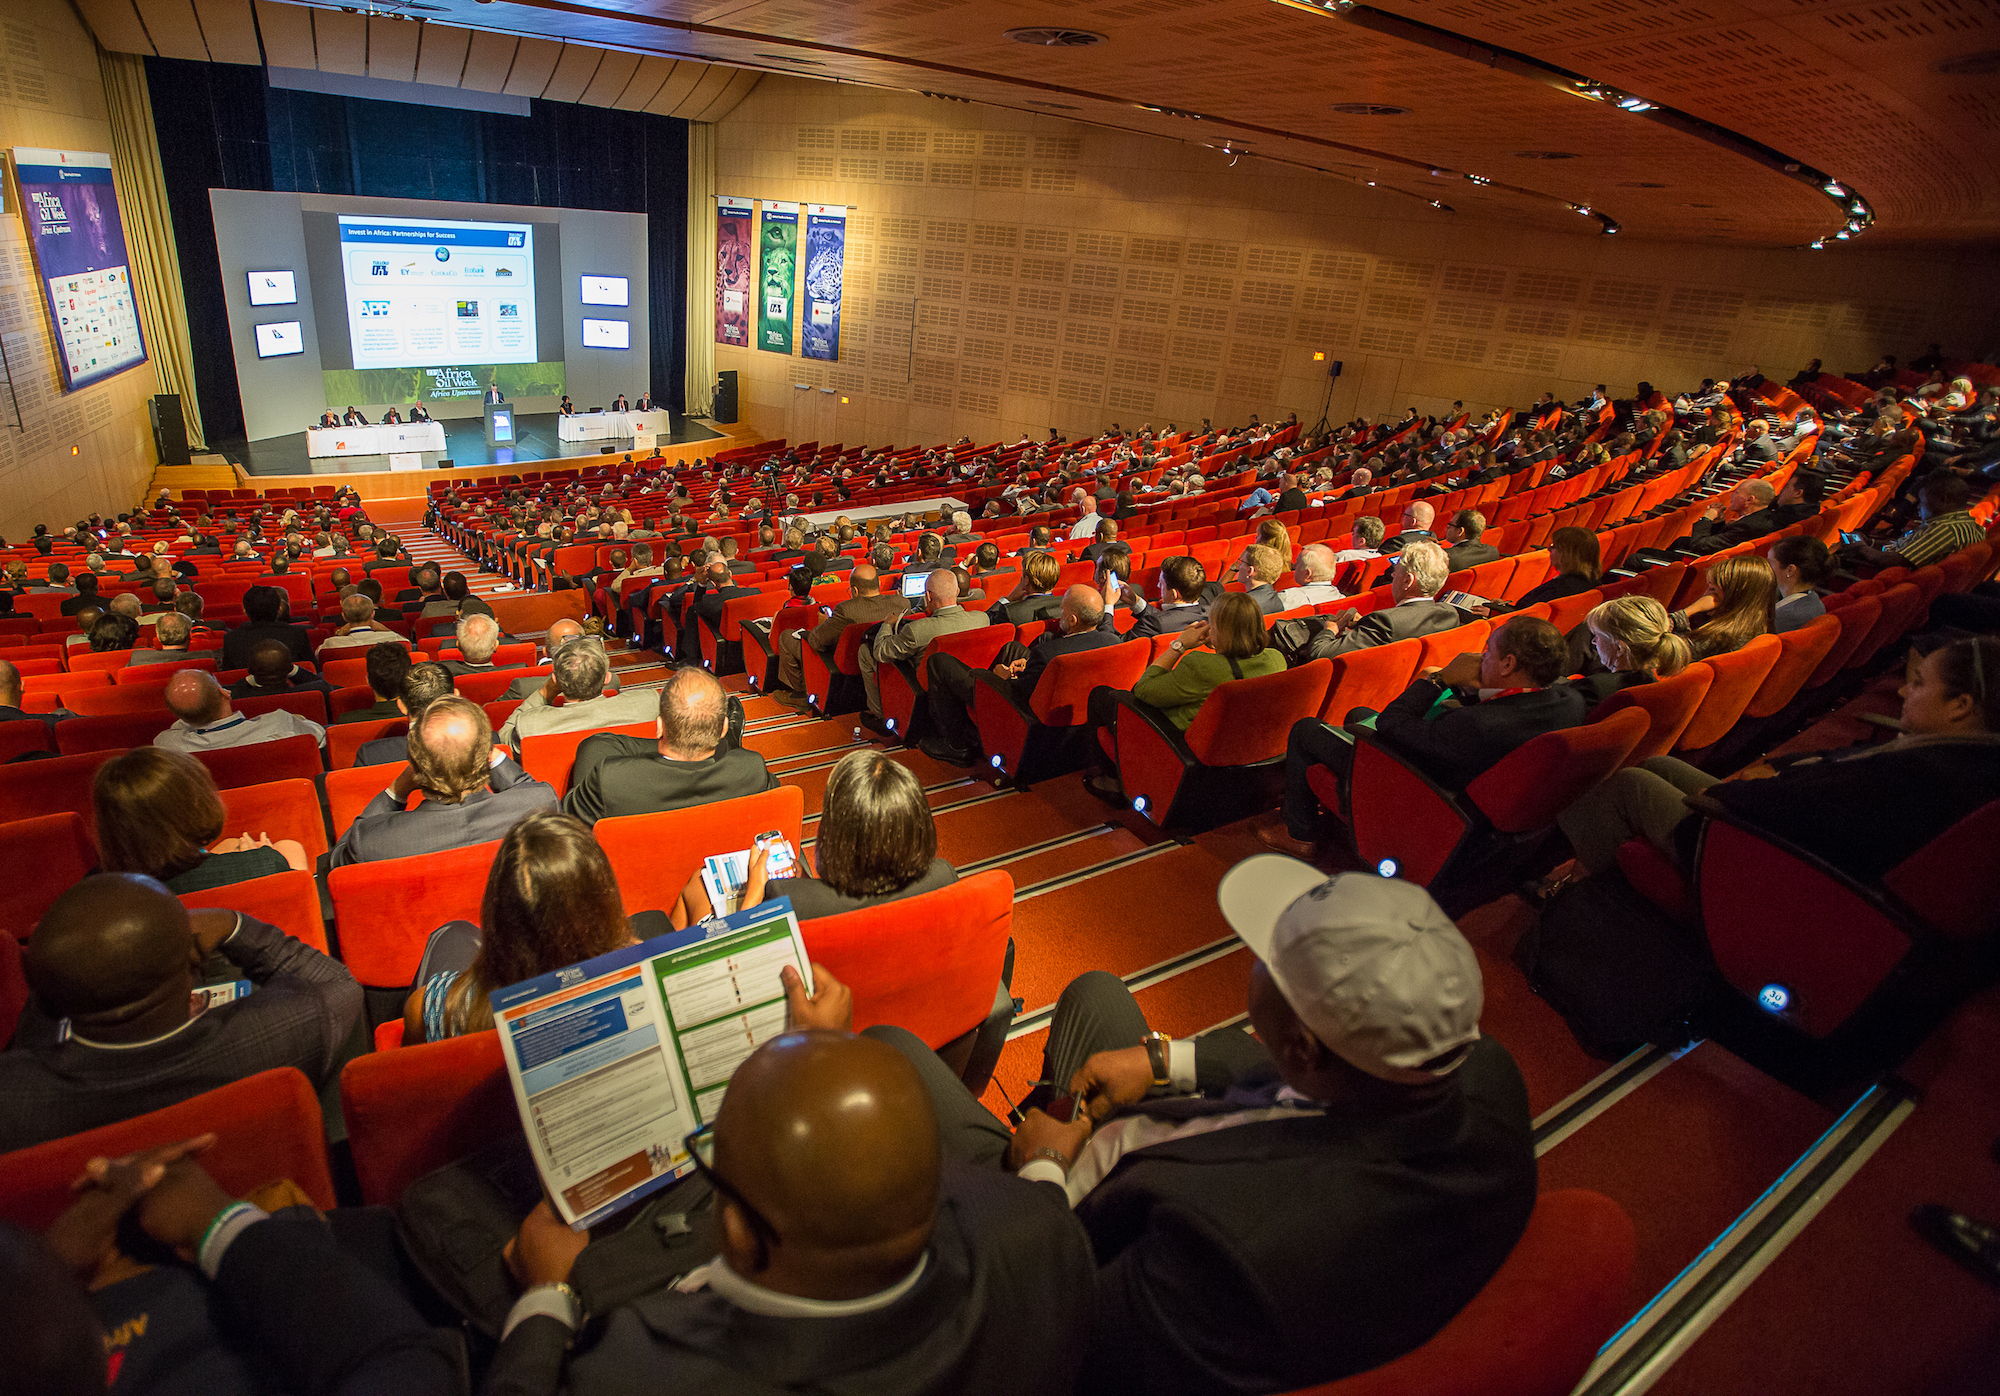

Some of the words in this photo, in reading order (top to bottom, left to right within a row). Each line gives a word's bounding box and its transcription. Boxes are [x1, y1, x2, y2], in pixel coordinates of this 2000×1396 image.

[392, 230, 426, 238] Partnerships
[361, 301, 390, 315] APP
[436, 368, 472, 379] Africa
[436, 378, 451, 388] Oil
[452, 377, 478, 387] Week
[1770, 990, 1782, 1001] 30
